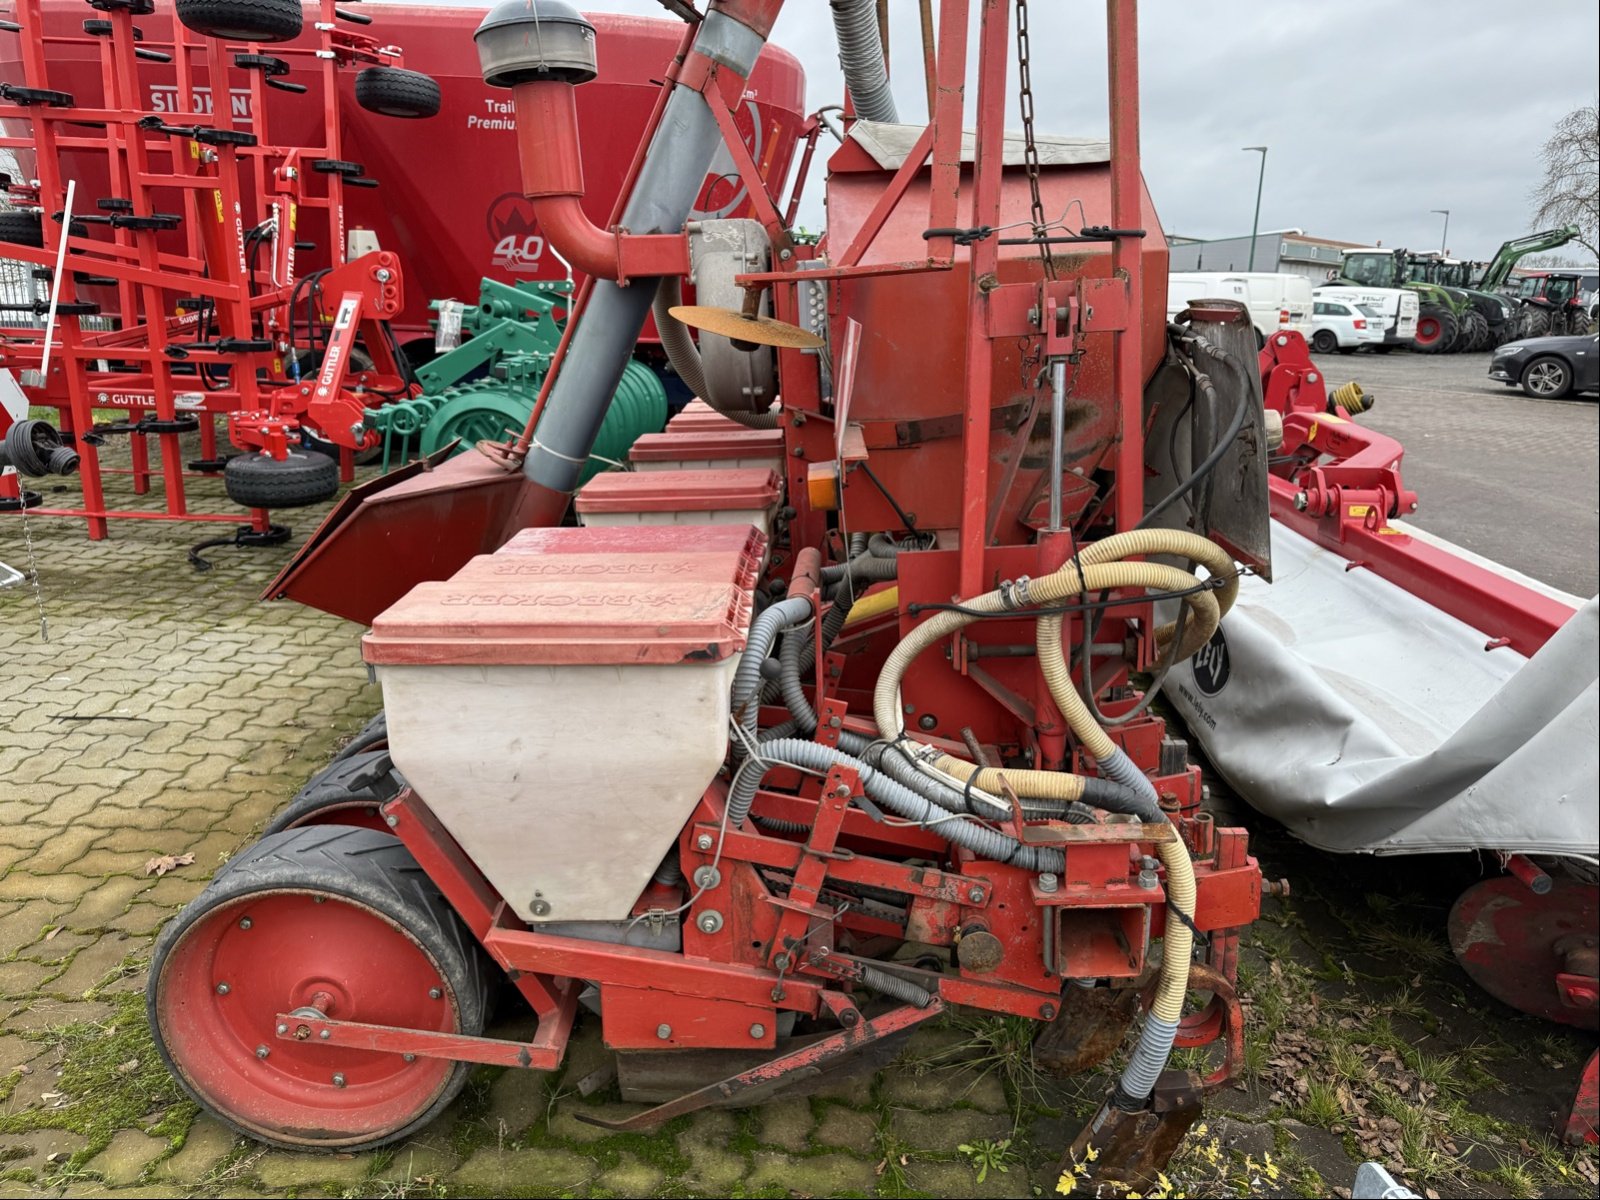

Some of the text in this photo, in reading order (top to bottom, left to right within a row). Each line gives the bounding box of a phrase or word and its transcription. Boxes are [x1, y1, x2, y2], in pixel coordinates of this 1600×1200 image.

[468, 115, 517, 129] Premiu
[440, 592, 639, 607] BECKER
[1195, 641, 1225, 687] LELY
